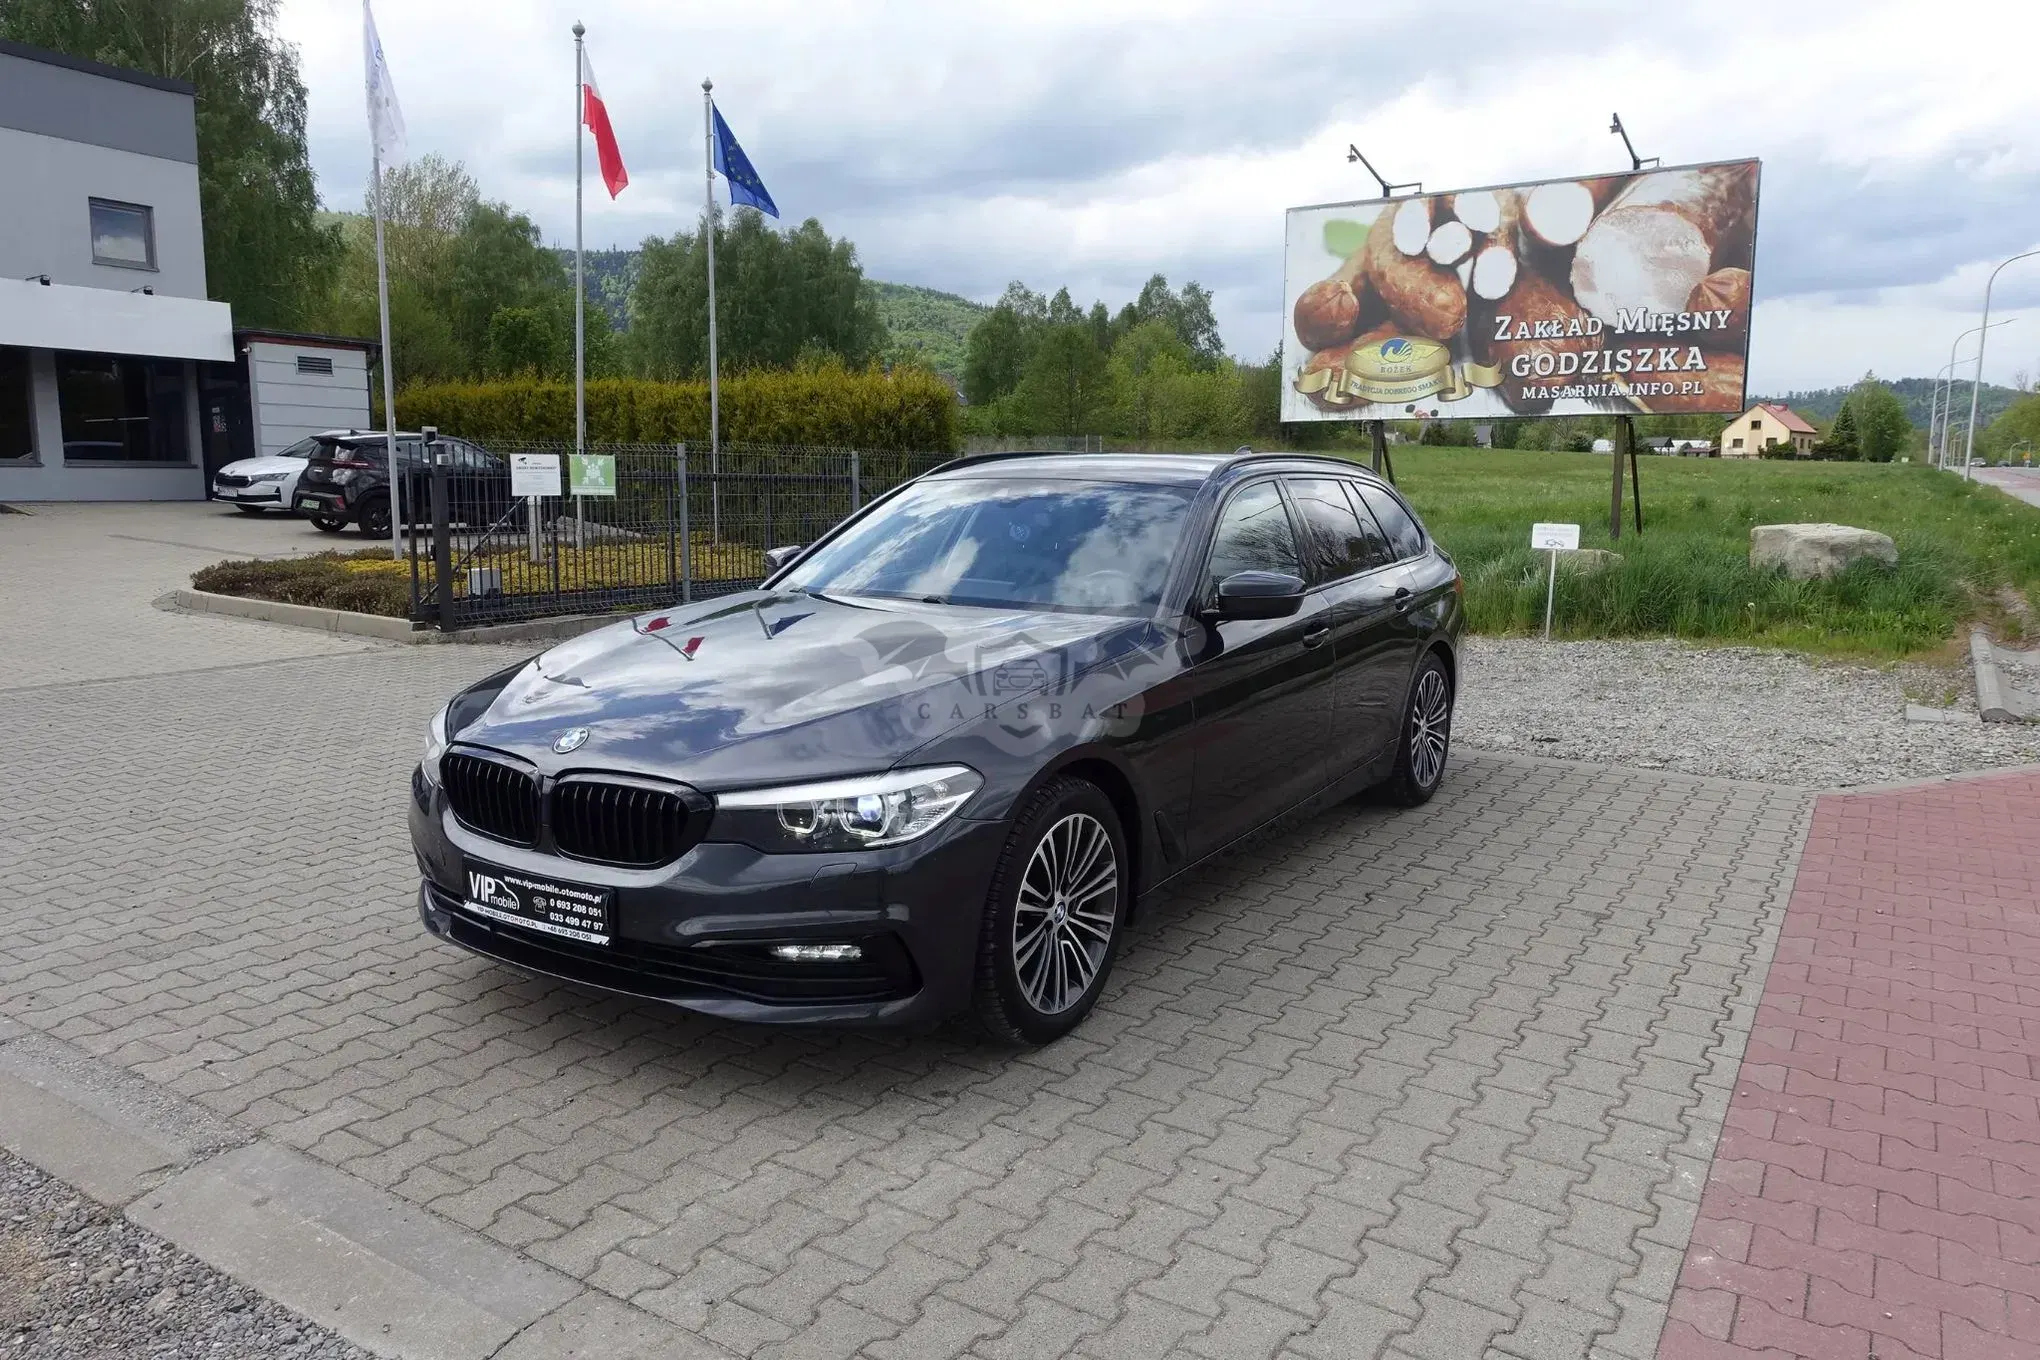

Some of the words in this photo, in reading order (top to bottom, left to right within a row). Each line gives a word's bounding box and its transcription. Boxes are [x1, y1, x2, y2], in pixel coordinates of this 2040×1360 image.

[1511, 345, 1707, 377] GODZISZKA
[1521, 381, 1704, 400] MASARNIA.INFO.PL
[469, 871, 496, 903] VIP
[504, 875, 602, 904] www.vip-mobile.otomoto.pl
[490, 895, 517, 910] mobile
[550, 898, 555, 907] 0
[556, 899, 571, 911] 693
[572, 903, 587, 914] 208
[588, 907, 602, 918] 051
[549, 912, 564, 922] 033
[565, 916, 580, 927] 499
[581, 919, 592, 929] 47
[593, 922, 604, 932] 97
